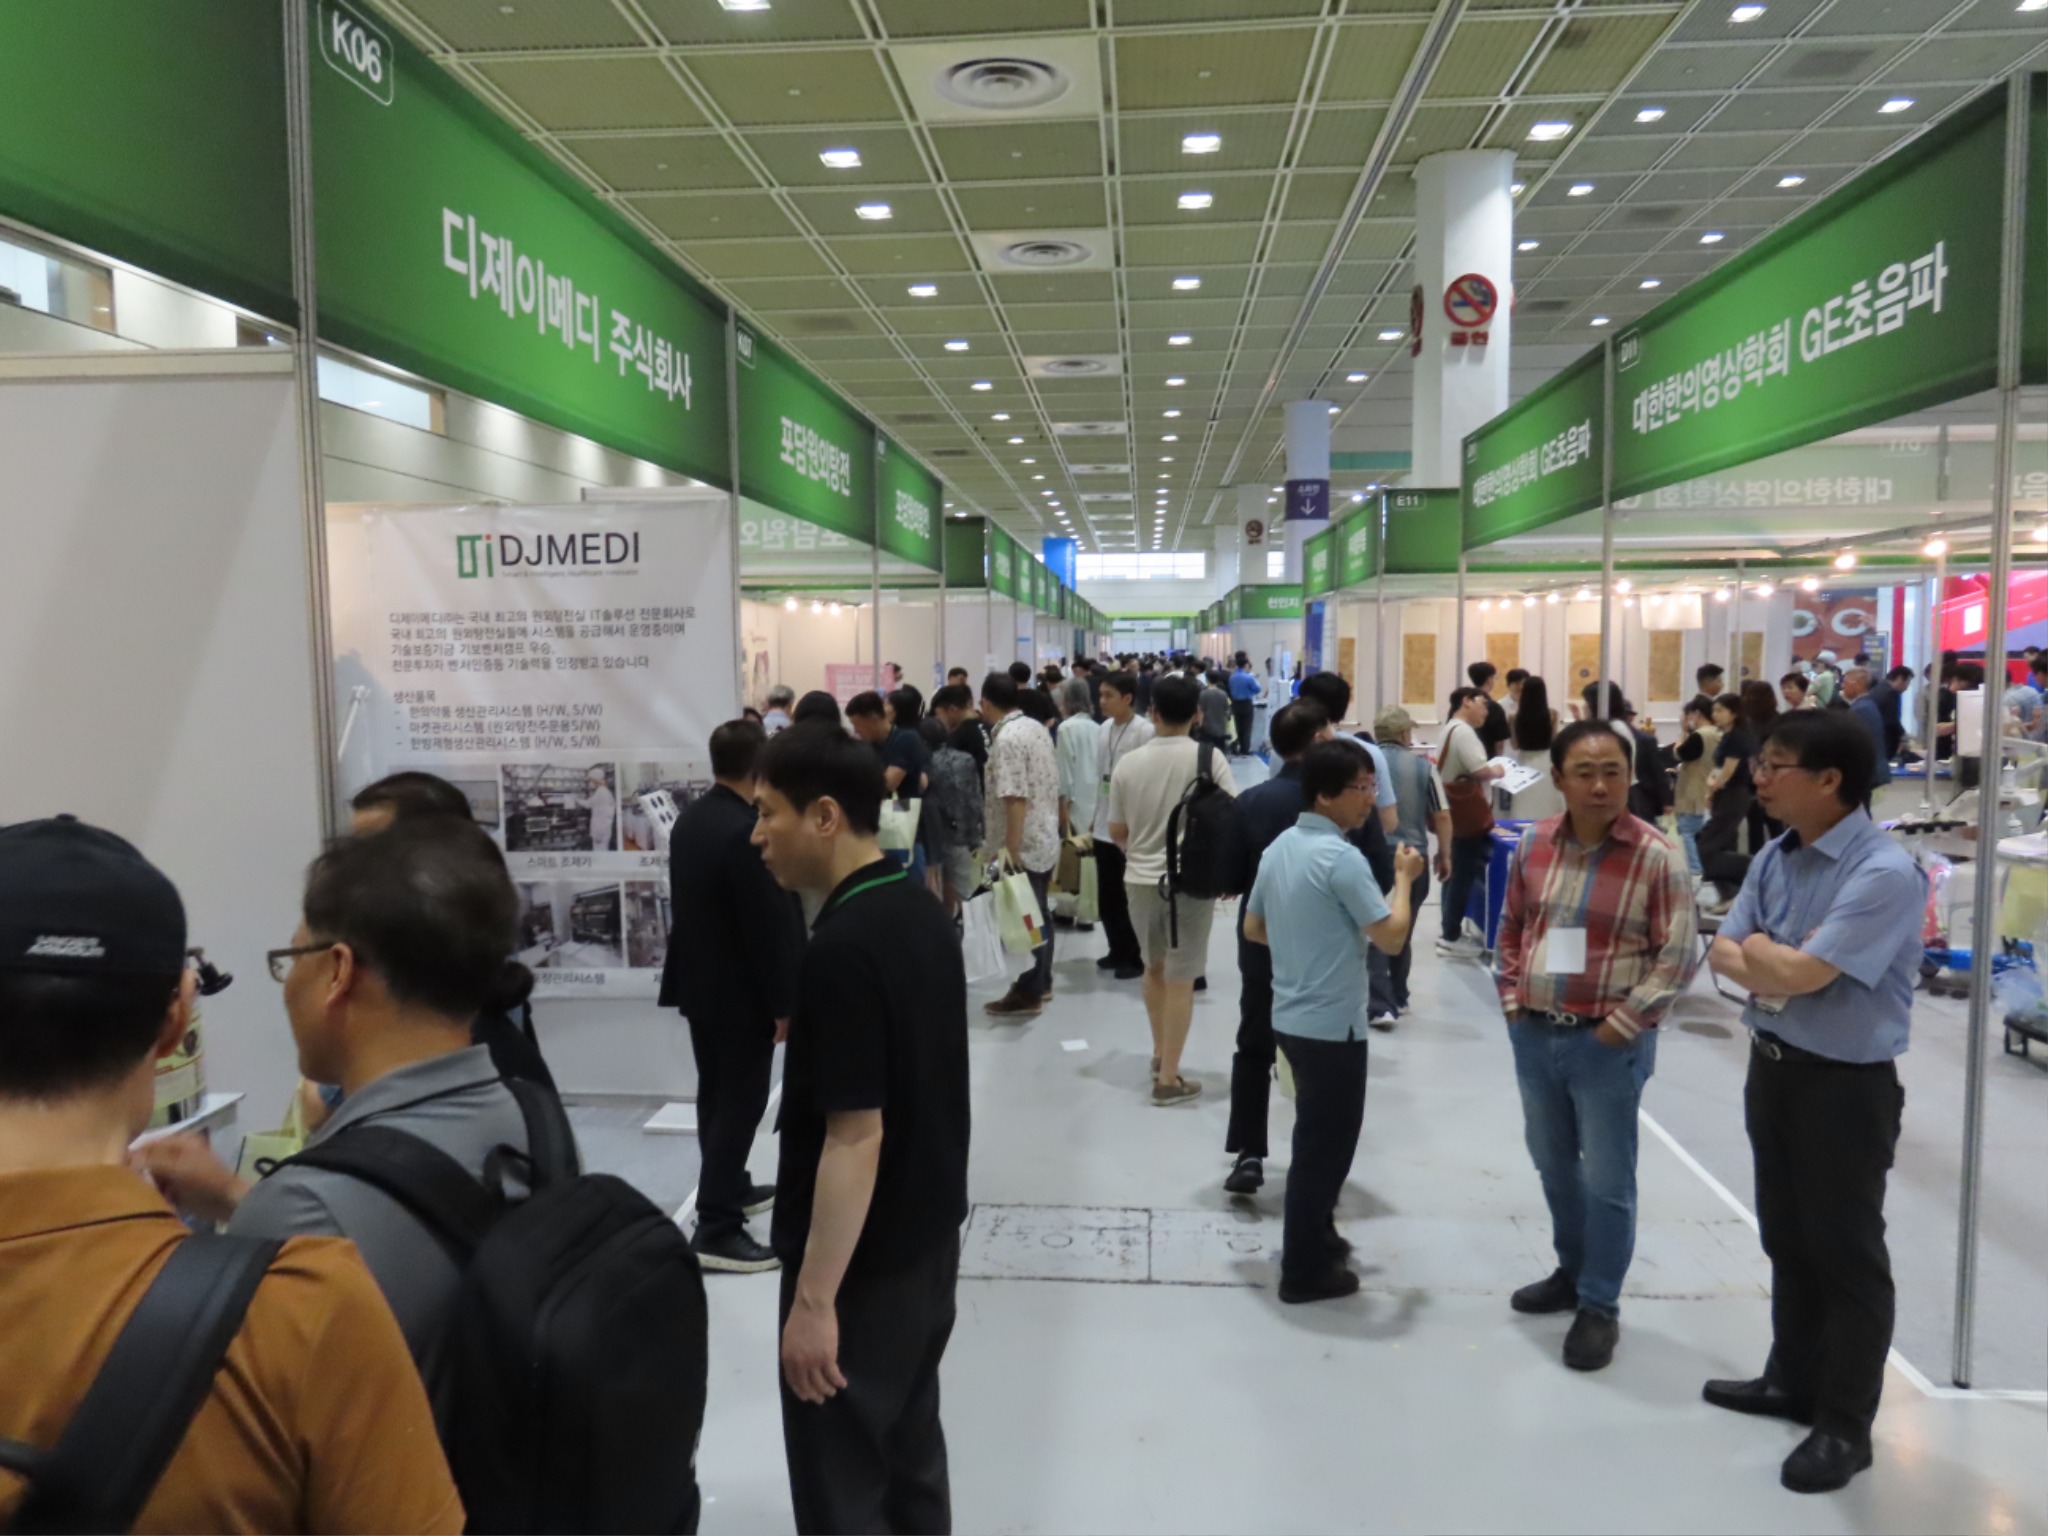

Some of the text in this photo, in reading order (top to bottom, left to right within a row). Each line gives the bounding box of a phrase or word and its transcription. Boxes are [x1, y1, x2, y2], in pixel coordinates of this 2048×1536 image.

[332, 10, 382, 83] K06
[442, 206, 692, 411] 디제이메디 주식회사
[1632, 240, 1949, 434] 대한한의영상학회 GE초음파
[1396, 495, 1419, 507] E11
[500, 532, 640, 566] DJMEDI
